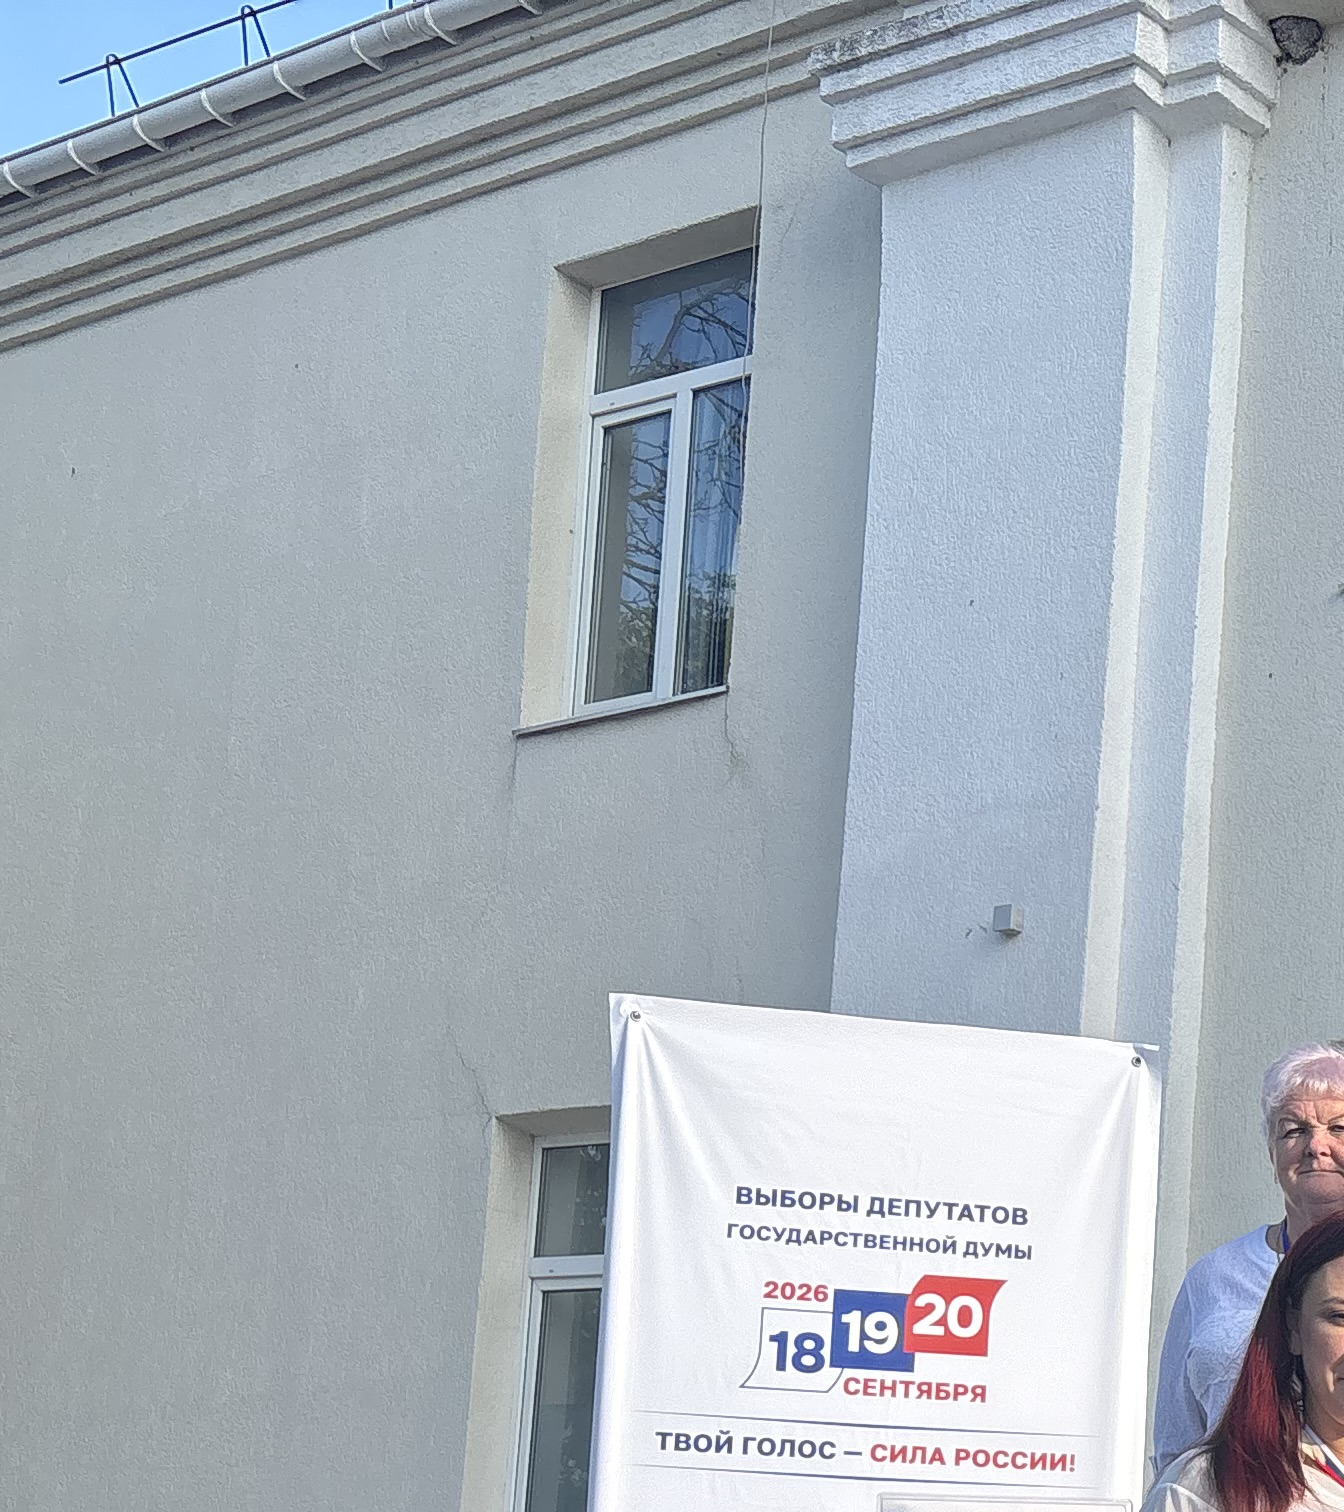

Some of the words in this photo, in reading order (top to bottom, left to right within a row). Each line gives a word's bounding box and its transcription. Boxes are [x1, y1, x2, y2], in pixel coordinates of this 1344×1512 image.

[735, 1185, 859, 1214] ВЫБОРЫ
[866, 1195, 1030, 1226] ДЕПУТАТОВ
[726, 1222, 957, 1255] ГОСУДАРСТВЕННОЙ
[962, 1240, 1033, 1261] ДУМЫ
[763, 1280, 829, 1302] 2026
[840, 1309, 899, 1354] 19
[912, 1292, 984, 1338] 20
[768, 1330, 826, 1374] 18
[843, 1376, 988, 1403] СЕНТЯБРЯ
[655, 1429, 734, 1455] ТВОЙ
[742, 1436, 837, 1460] ГОЛОС
[869, 1443, 946, 1466] СИЛА
[954, 1447, 1076, 1473] РОССИИ!
